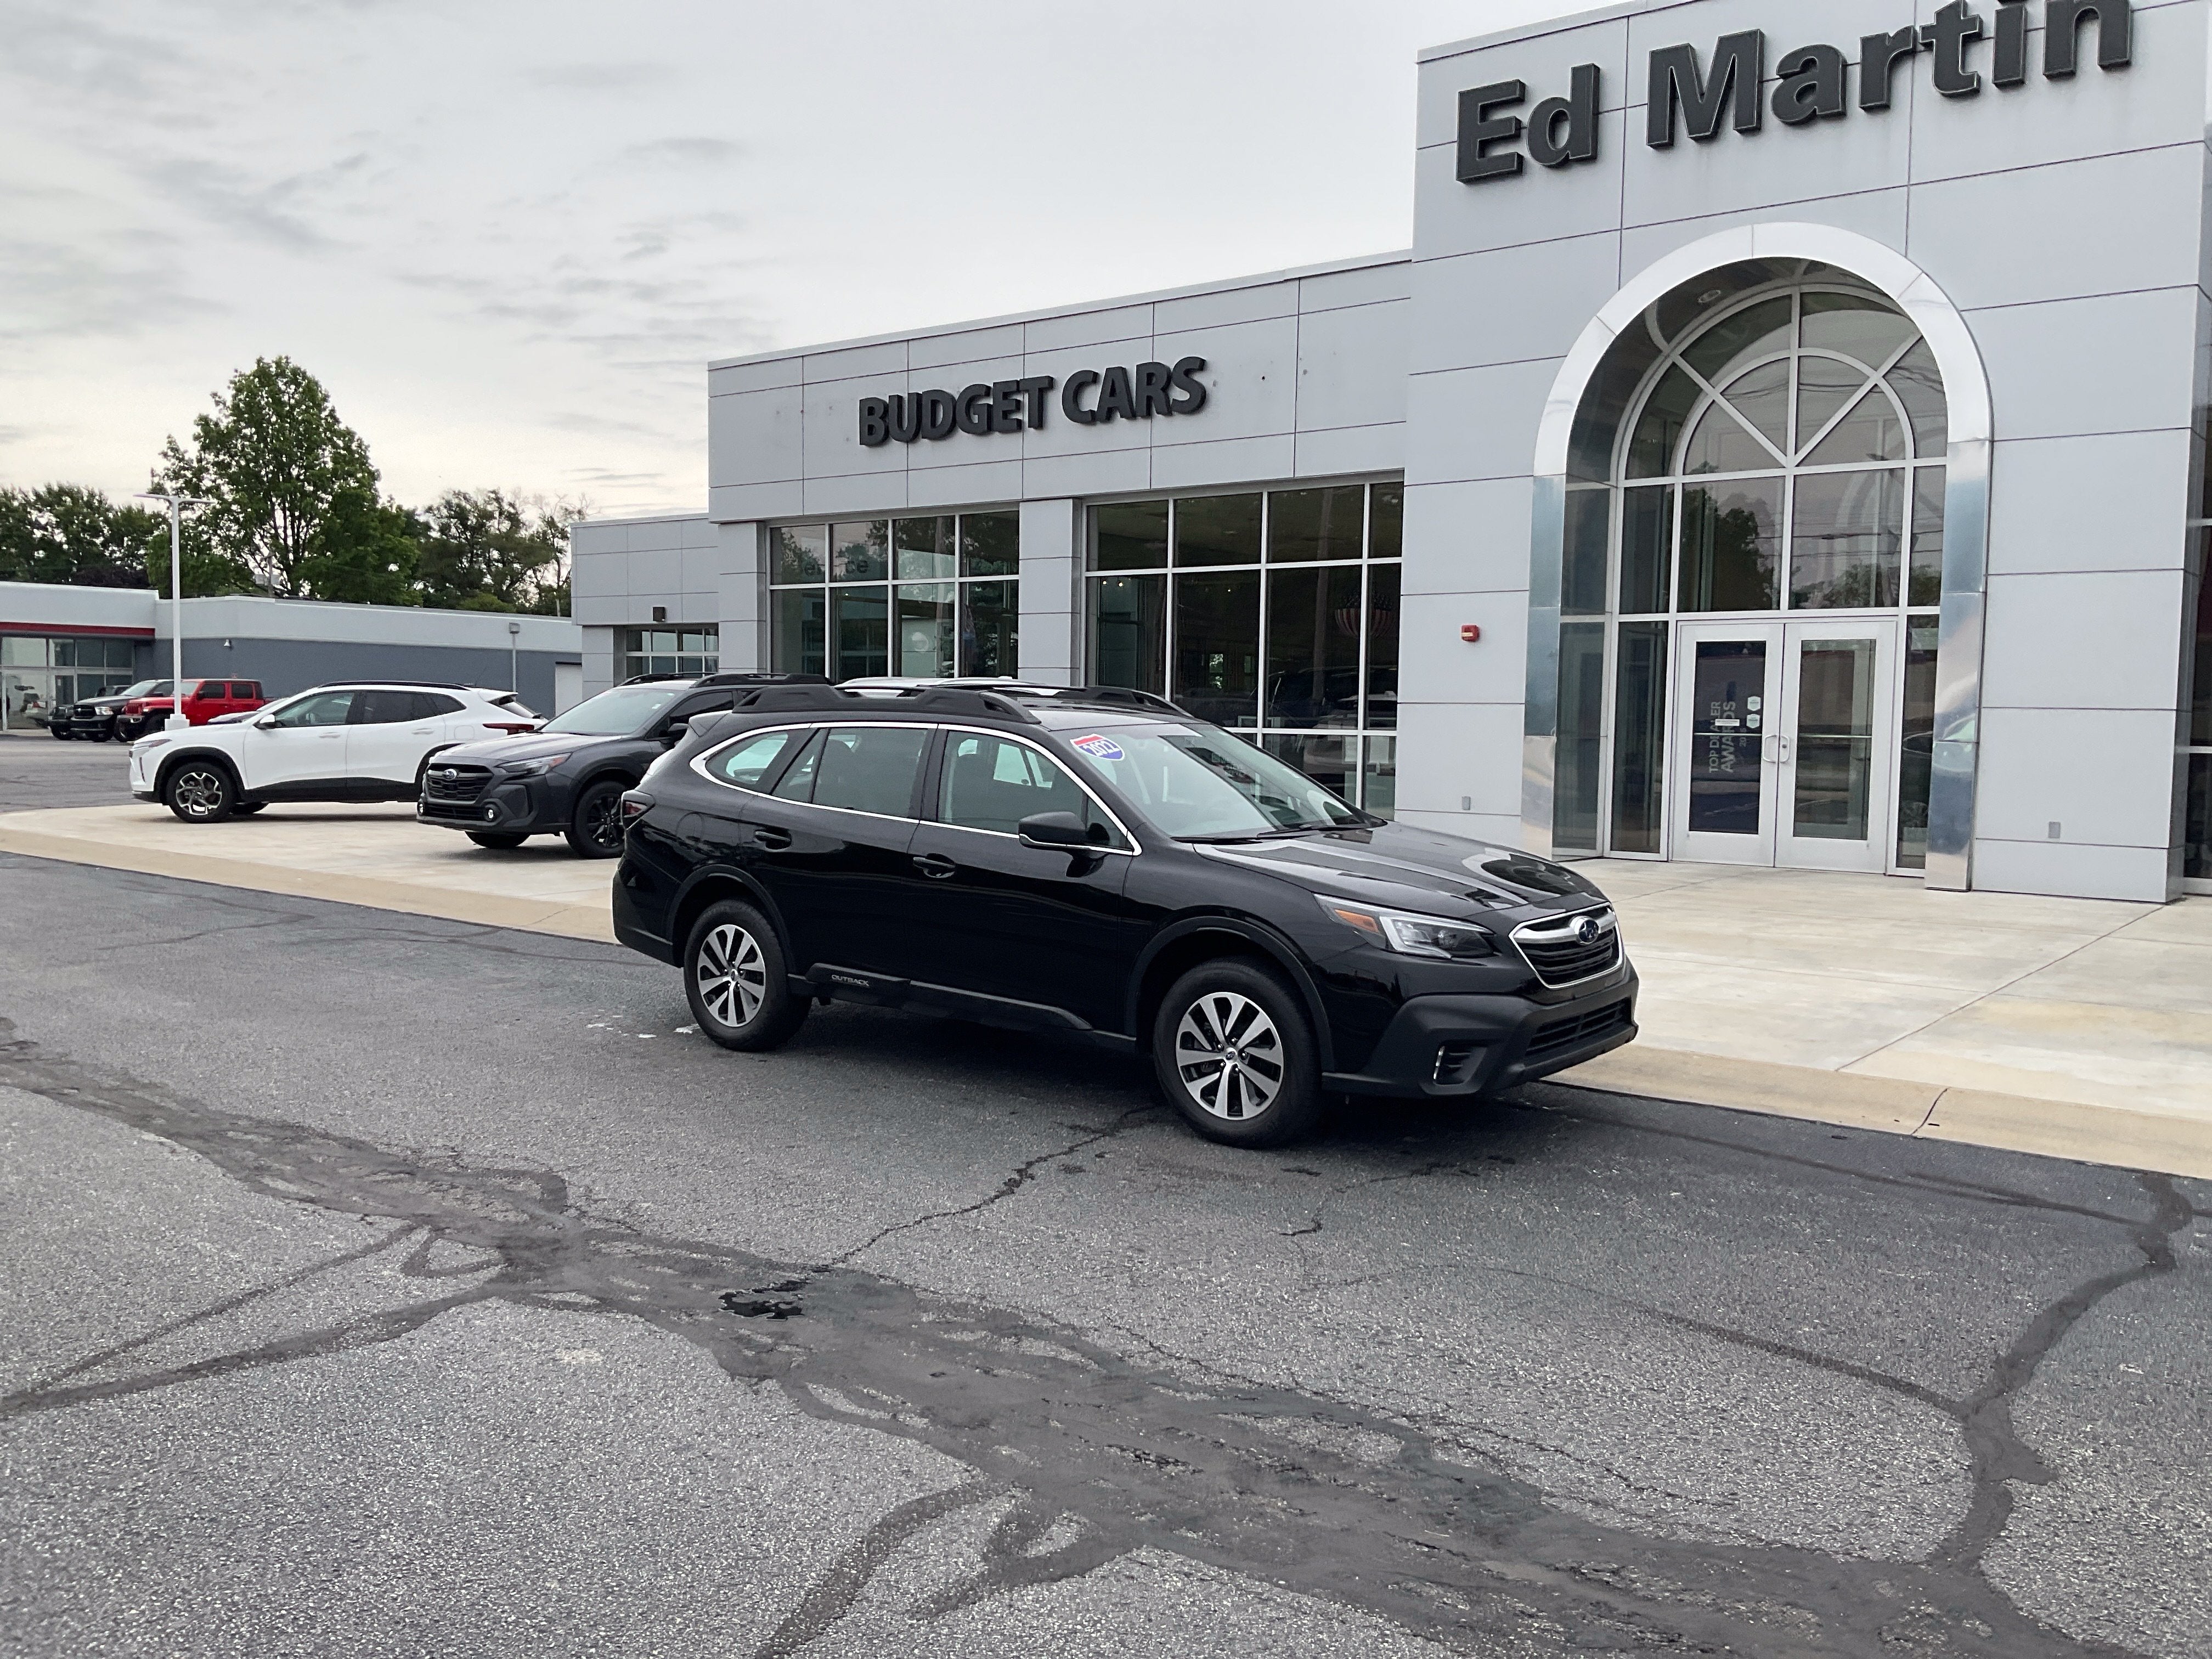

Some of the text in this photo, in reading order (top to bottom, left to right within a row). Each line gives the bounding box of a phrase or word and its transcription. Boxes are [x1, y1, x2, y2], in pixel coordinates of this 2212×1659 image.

[1455, 0, 2131, 184] Ed Martin
[859, 356, 1206, 447] BUDGET CARS
[1083, 741, 1120, 756] 2022
[1709, 750, 1719, 773] TOP
[832, 974, 869, 986] OUTBACK
